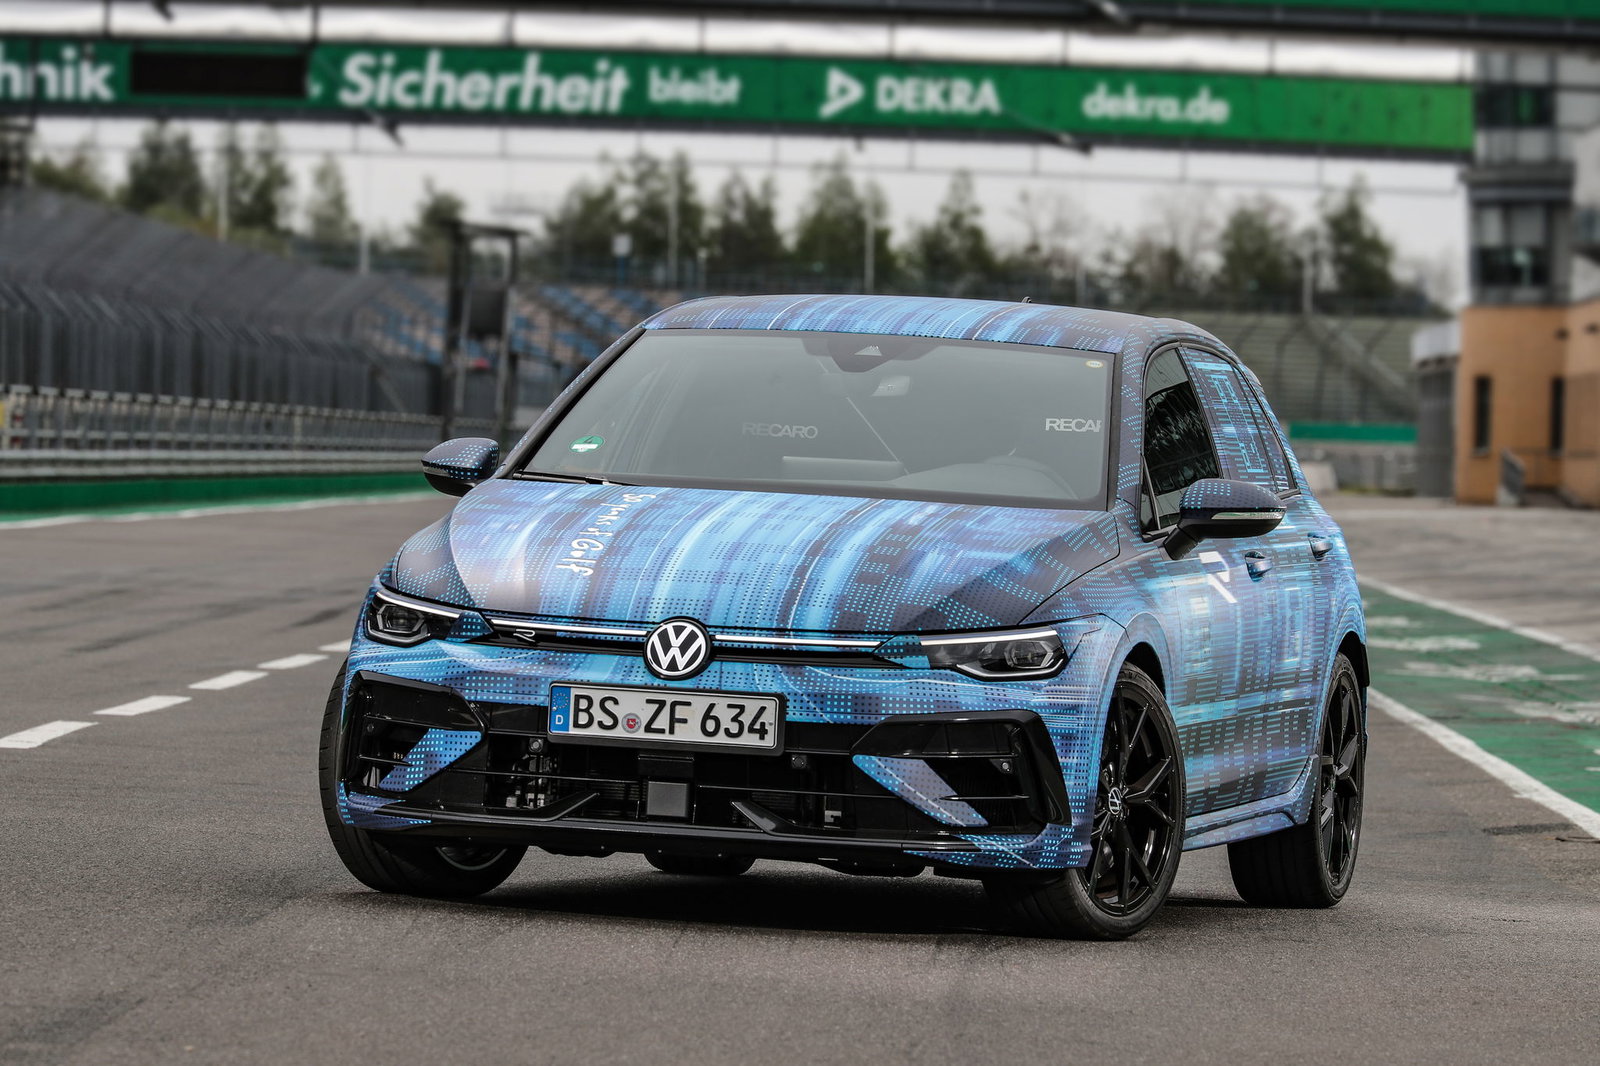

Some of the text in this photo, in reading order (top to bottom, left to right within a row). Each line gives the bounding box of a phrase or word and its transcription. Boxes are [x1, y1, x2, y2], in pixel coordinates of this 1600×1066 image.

[339, 50, 739, 112] Sicherheit bleibt
[877, 76, 1001, 114] DEKRA
[1083, 82, 1230, 123] dekra.de
[742, 422, 818, 439] RECARO
[556, 538, 604, 577] Golf
[555, 693, 768, 740] D BS ZF 634
